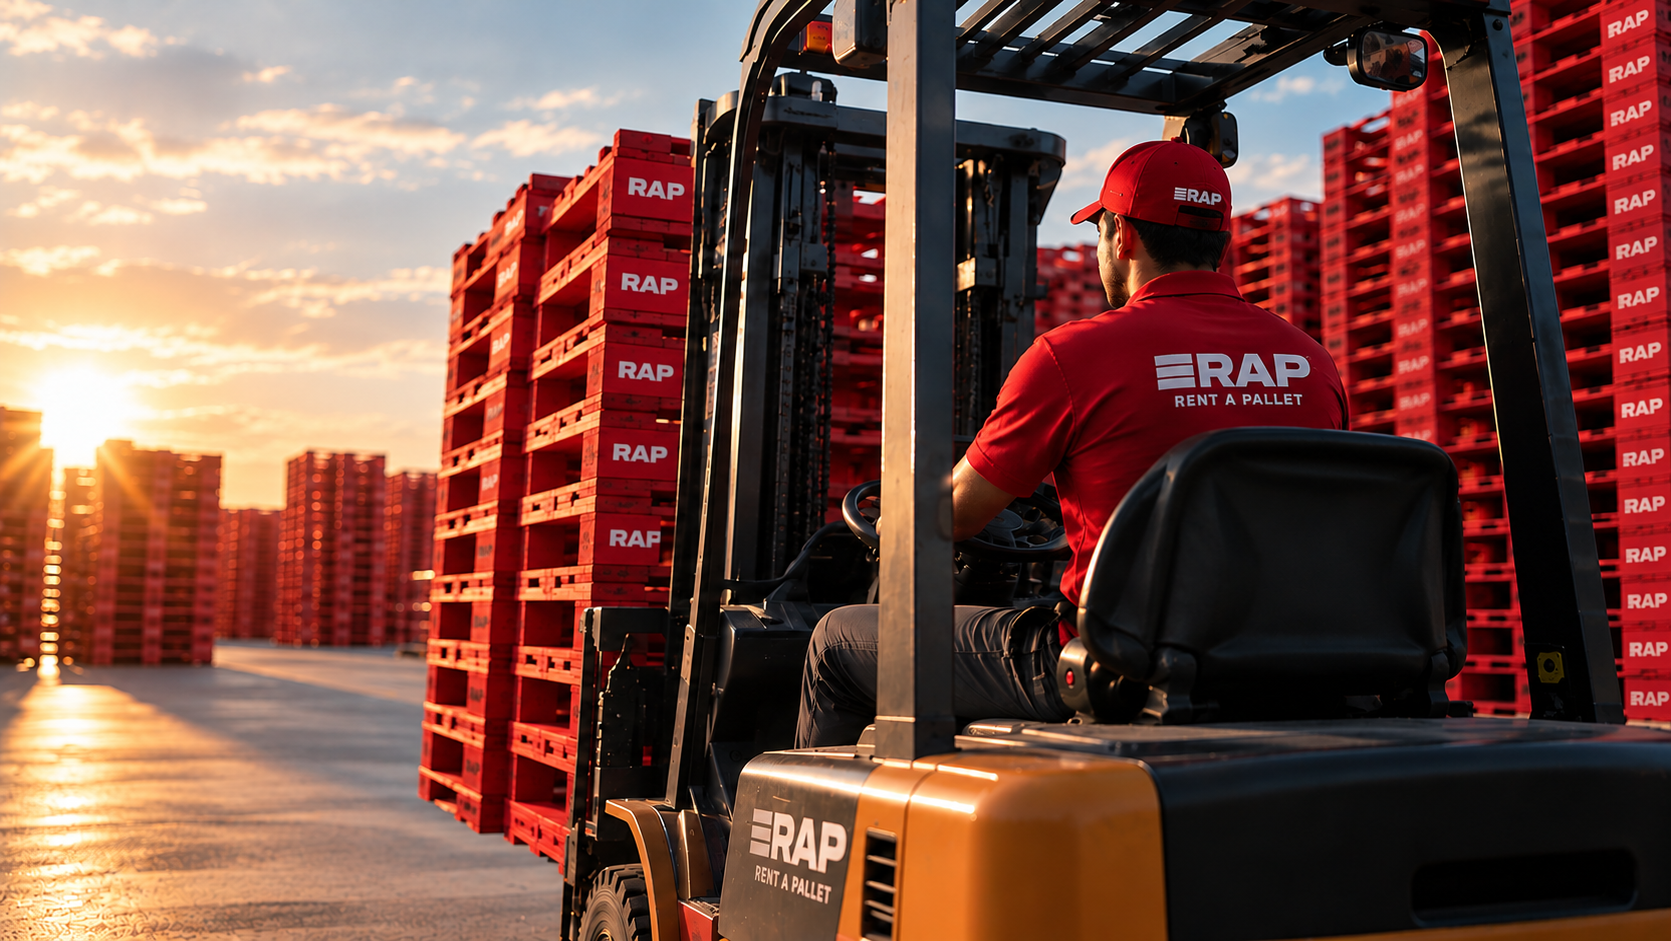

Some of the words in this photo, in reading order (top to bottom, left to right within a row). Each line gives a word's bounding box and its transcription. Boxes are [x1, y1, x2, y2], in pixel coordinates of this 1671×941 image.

[1608, 10, 1649, 39] RAP
[1609, 56, 1650, 84] RAP
[1611, 100, 1652, 127] RAP
[1613, 144, 1654, 171] RAP
[628, 177, 685, 200] RAP
[1187, 189, 1222, 205] RAP
[1614, 189, 1656, 214] RAP
[1616, 236, 1658, 260] RAP
[621, 273, 678, 295] RAP
[1618, 287, 1660, 309] RAP
[1620, 342, 1661, 363] RAP
[618, 361, 674, 382] RAP
[1196, 353, 1310, 387] RAP
[1174, 393, 1218, 407] RENT
[1225, 393, 1236, 405] A
[1242, 393, 1302, 406] PALLET
[1622, 398, 1663, 418] RAP
[613, 443, 668, 464] RAP
[1623, 448, 1664, 467] RAP
[1624, 496, 1665, 514] RAP
[609, 529, 661, 548] RAP
[1626, 546, 1667, 563] RAP
[1628, 593, 1668, 609] RAP
[1629, 642, 1668, 657] RAP
[1631, 691, 1670, 706] RAP
[771, 812, 847, 873] RAP
[754, 865, 780, 887] RENT
[781, 873, 789, 891] A
[792, 875, 832, 904] PALLET
